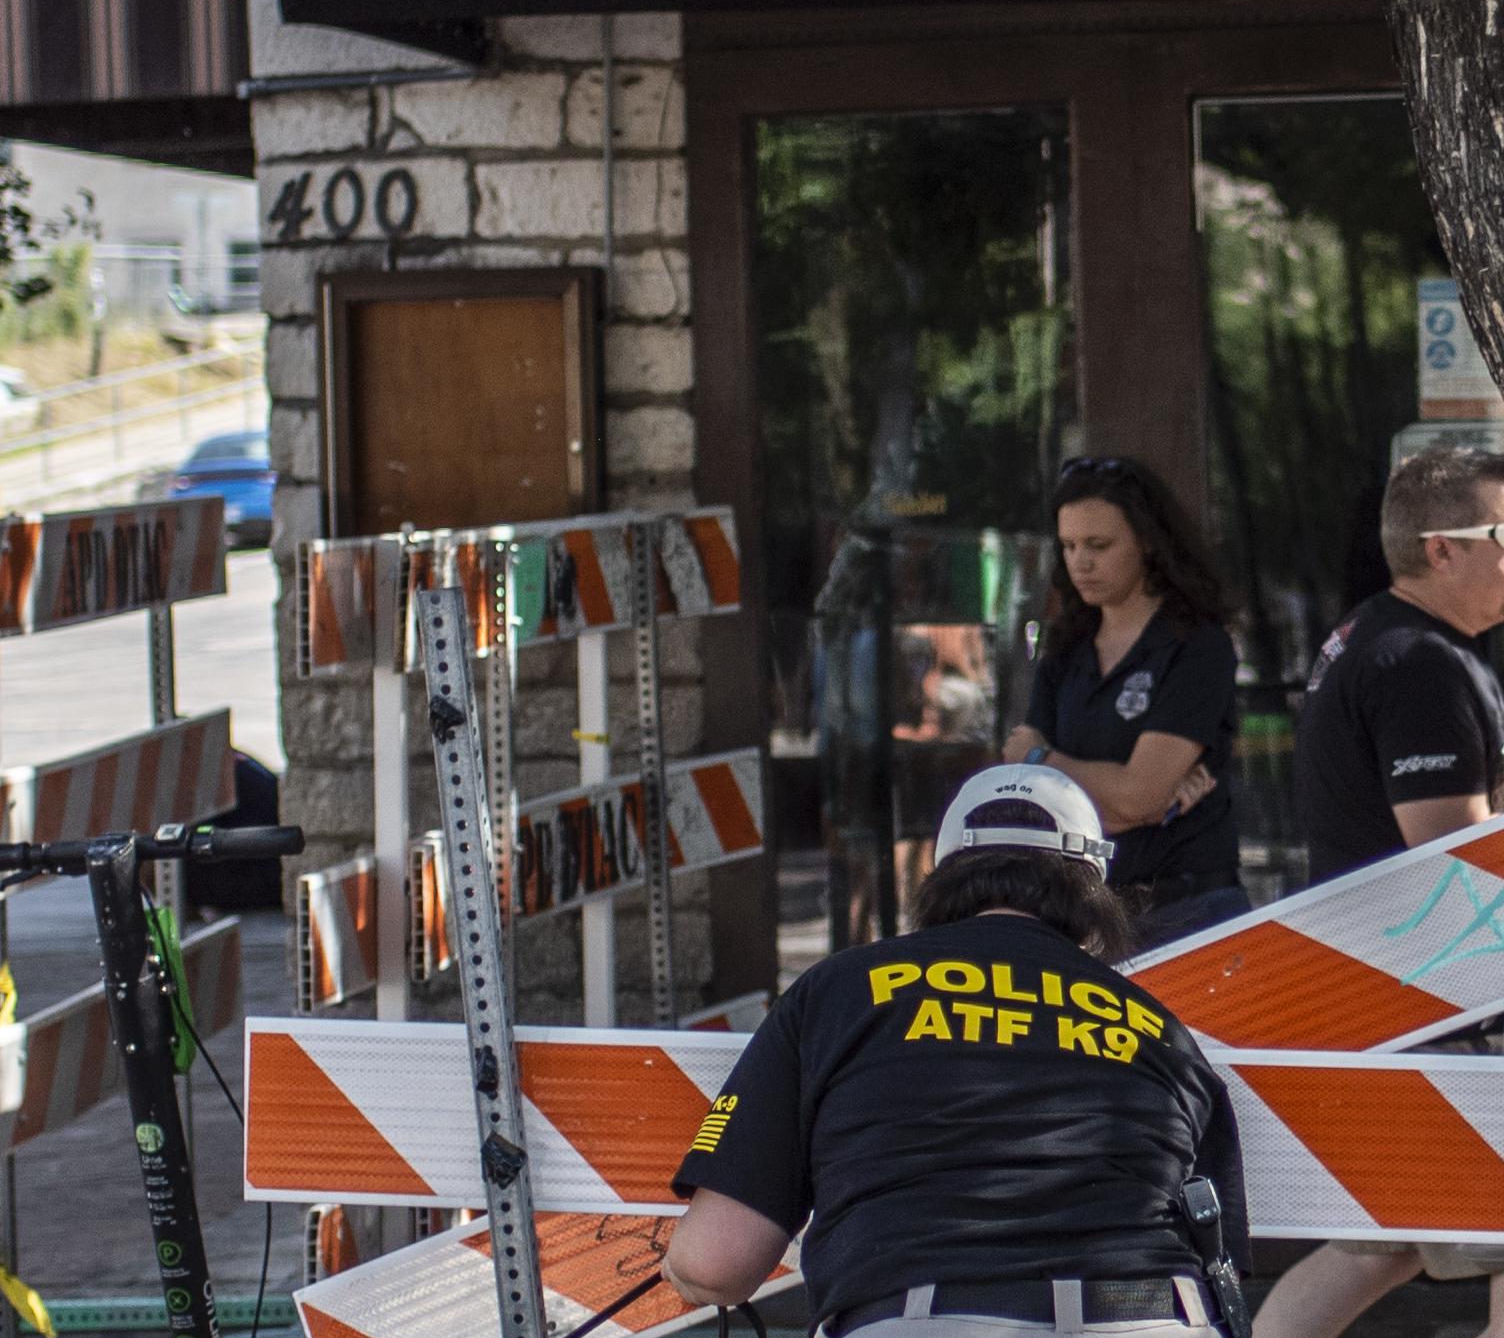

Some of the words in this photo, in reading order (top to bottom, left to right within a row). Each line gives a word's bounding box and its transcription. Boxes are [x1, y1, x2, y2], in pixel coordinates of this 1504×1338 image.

[270, 168, 419, 240] 400
[995, 783, 1017, 794] wag
[1019, 785, 1033, 795] on
[867, 959, 1165, 1041] POLICE
[904, 997, 1033, 1047] ATF
[1056, 1014, 1142, 1066] K9
[711, 1094, 740, 1113] K-9
